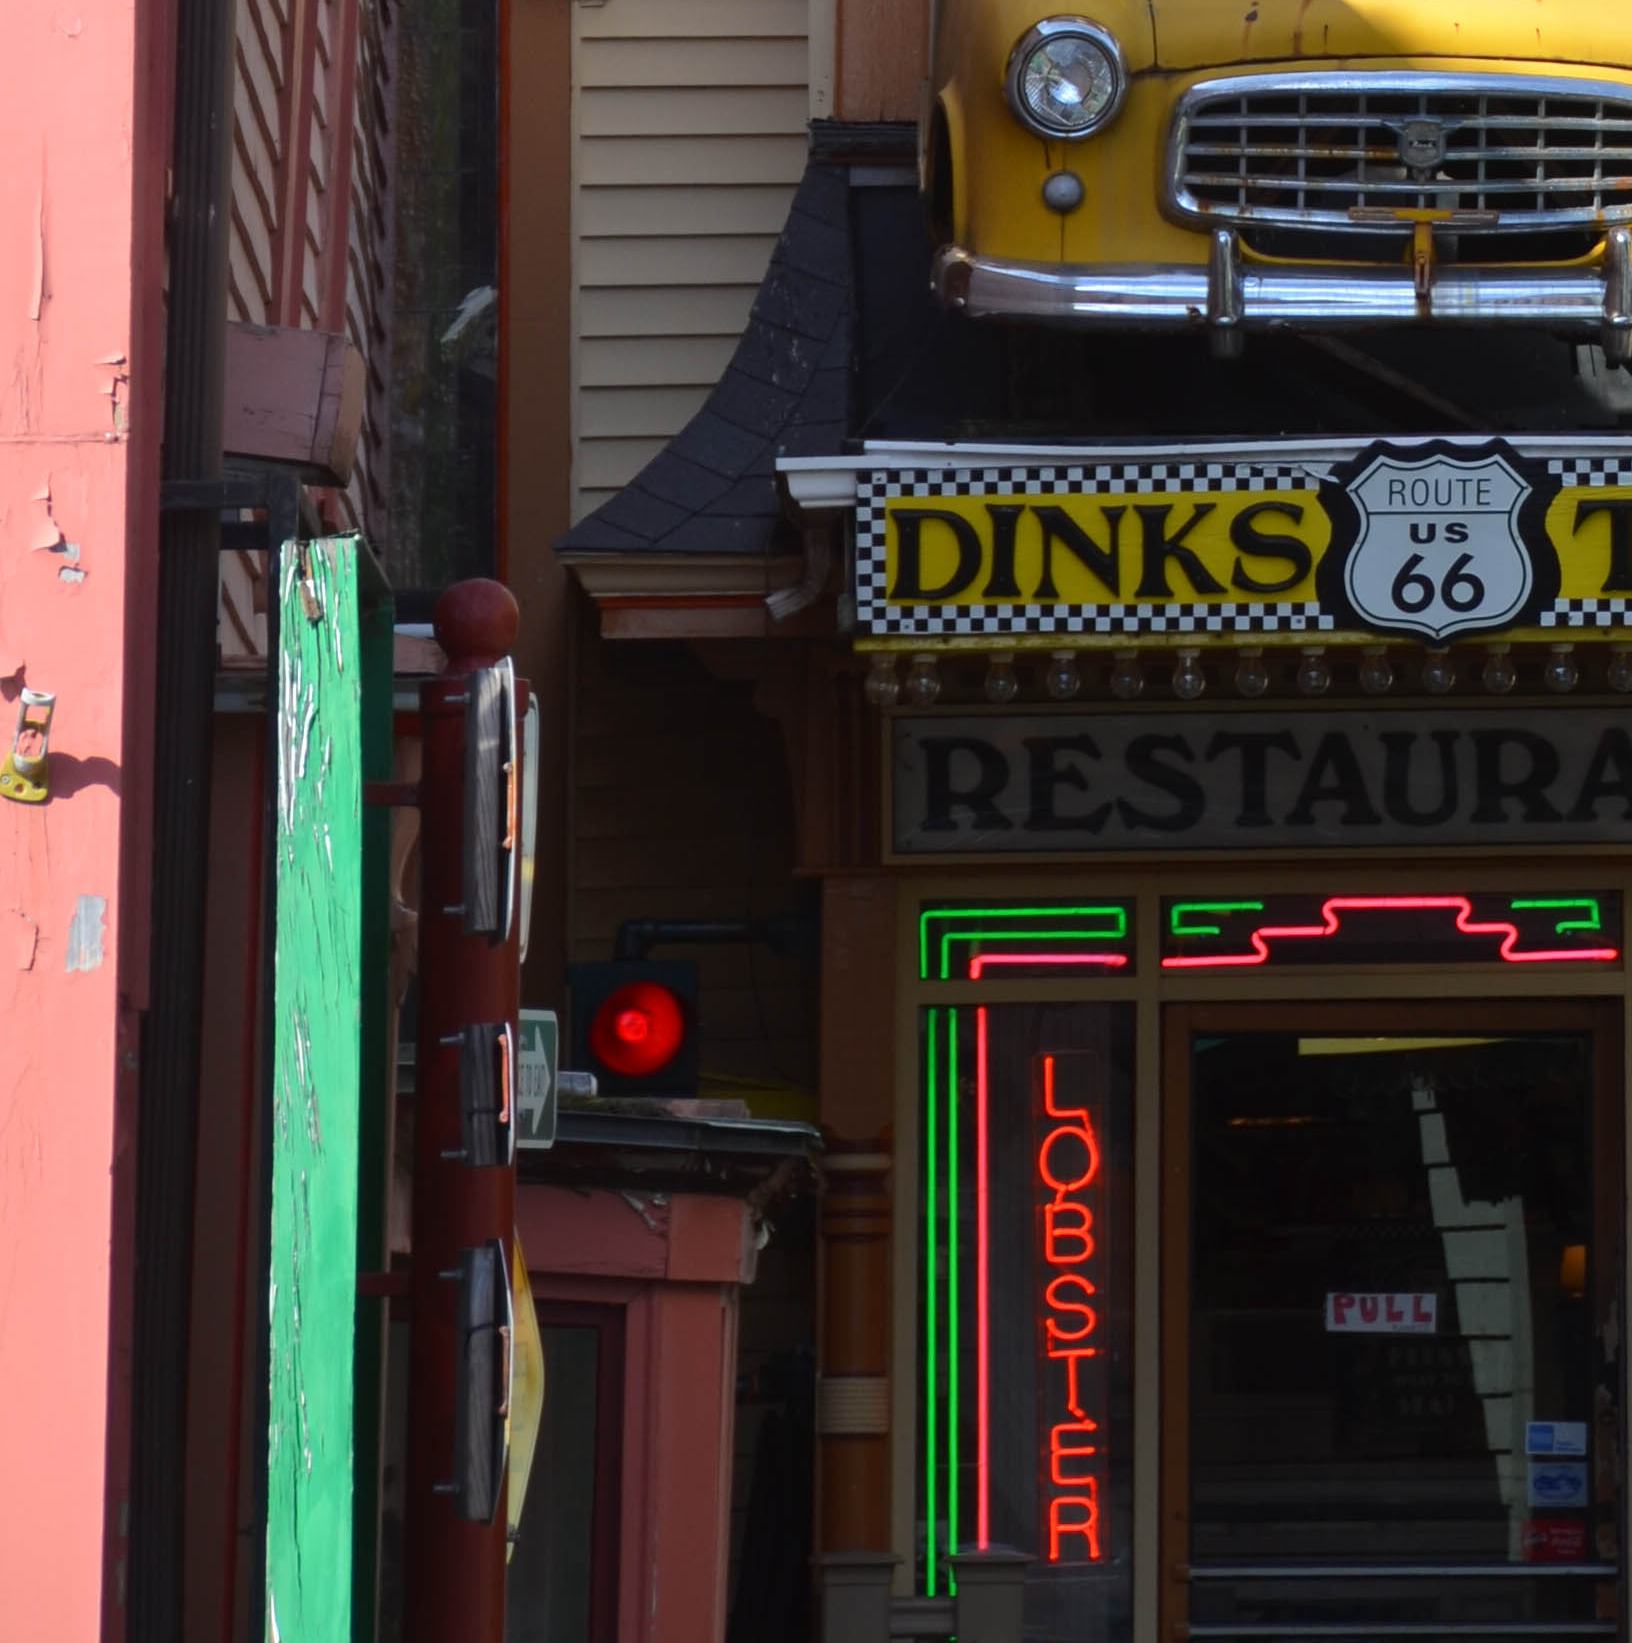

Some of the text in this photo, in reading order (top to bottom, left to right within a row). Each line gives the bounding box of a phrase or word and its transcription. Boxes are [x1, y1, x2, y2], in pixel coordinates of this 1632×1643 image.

[1388, 478, 1492, 507] ROUTE
[887, 501, 1313, 600] DINKS
[1409, 522, 1469, 545] US
[1391, 552, 1486, 614] 66
[1038, 1054, 1101, 1563] LOBSTER
[1333, 1294, 1433, 1325] PULL
